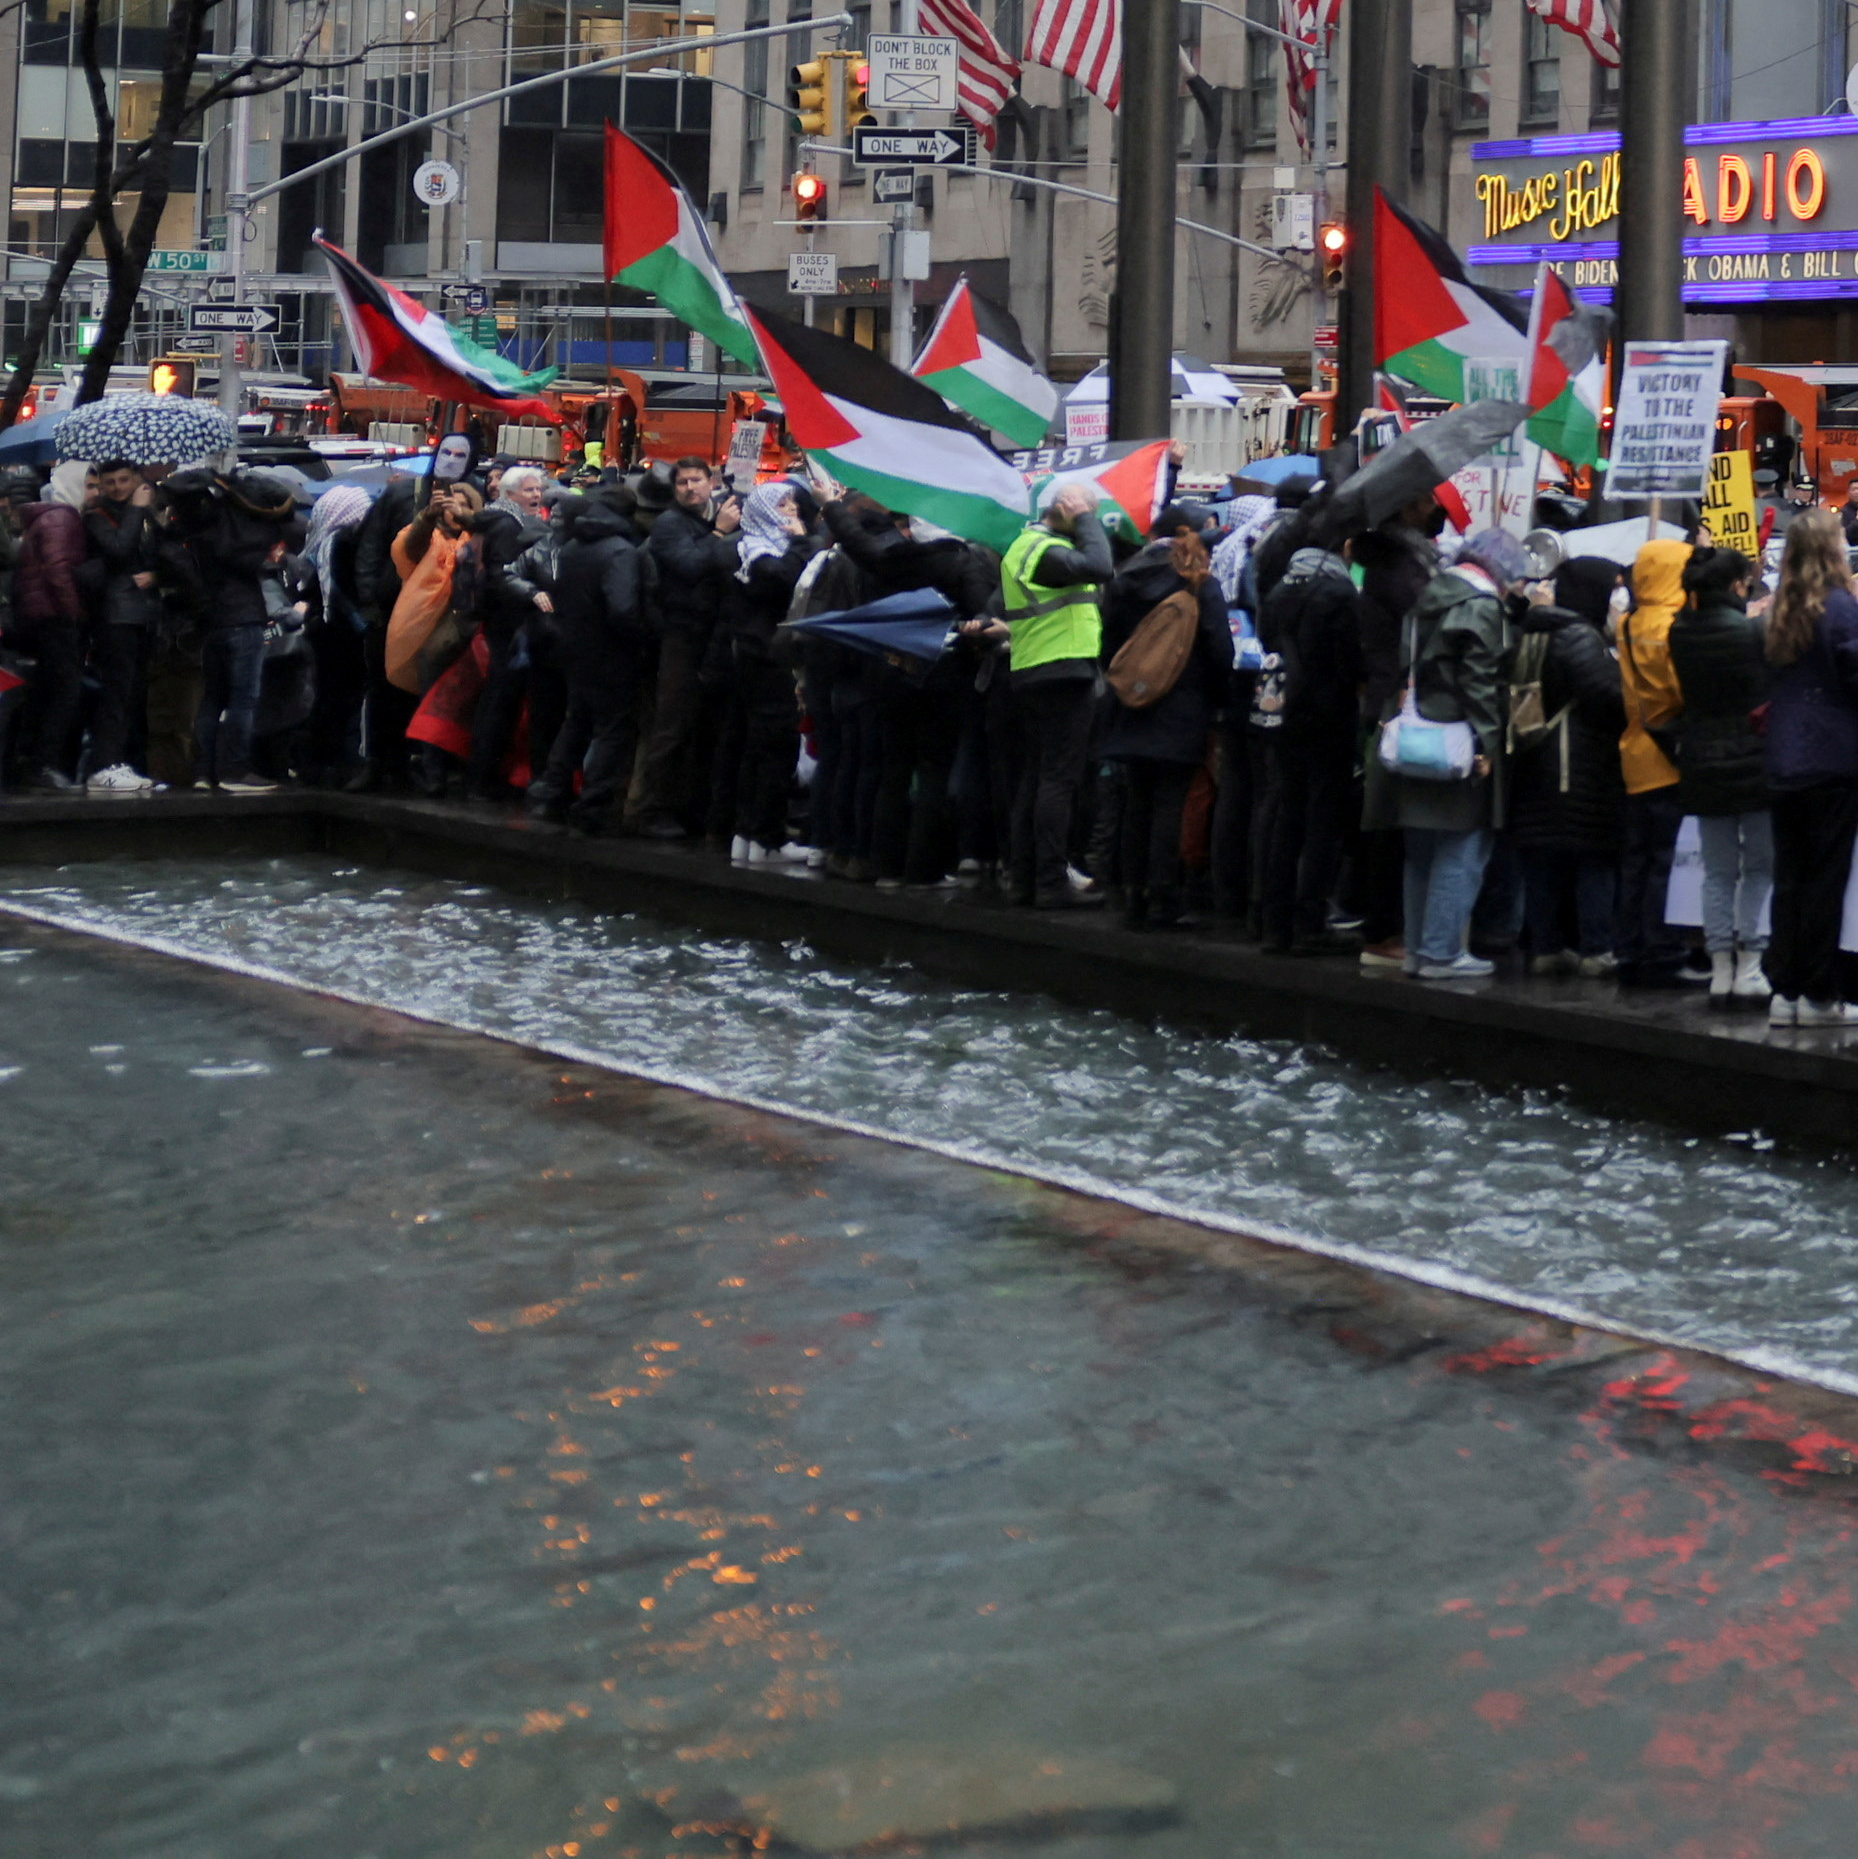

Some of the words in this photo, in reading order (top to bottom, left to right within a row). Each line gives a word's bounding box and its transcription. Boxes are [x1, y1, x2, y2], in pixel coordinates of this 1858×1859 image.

[874, 40, 909, 53] DON'T
[913, 41, 951, 56] BLOCK
[889, 57, 910, 70] THE
[915, 58, 938, 71] BOX
[871, 139, 902, 153] ONE
[917, 140, 949, 154] WAY
[1475, 173, 1557, 239] Music
[1549, 150, 1621, 240] Hall
[166, 252, 193, 270] 50
[194, 253, 207, 263] ST
[796, 255, 829, 265] BUSES
[1708, 252, 1770, 282] OBAMA
[1780, 252, 1792, 279] &
[1803, 251, 1842, 278] BILL
[799, 266, 825, 277] ONLY
[200, 314, 224, 324] ONE
[236, 314, 262, 324] WAY
[1637, 374, 1702, 393] VICTORY
[1643, 398, 1660, 418] TO
[1664, 398, 1694, 417] THE
[1069, 413, 1100, 426] HANDS
[740, 427, 759, 443] FREE
[1723, 511, 1750, 536] AID
